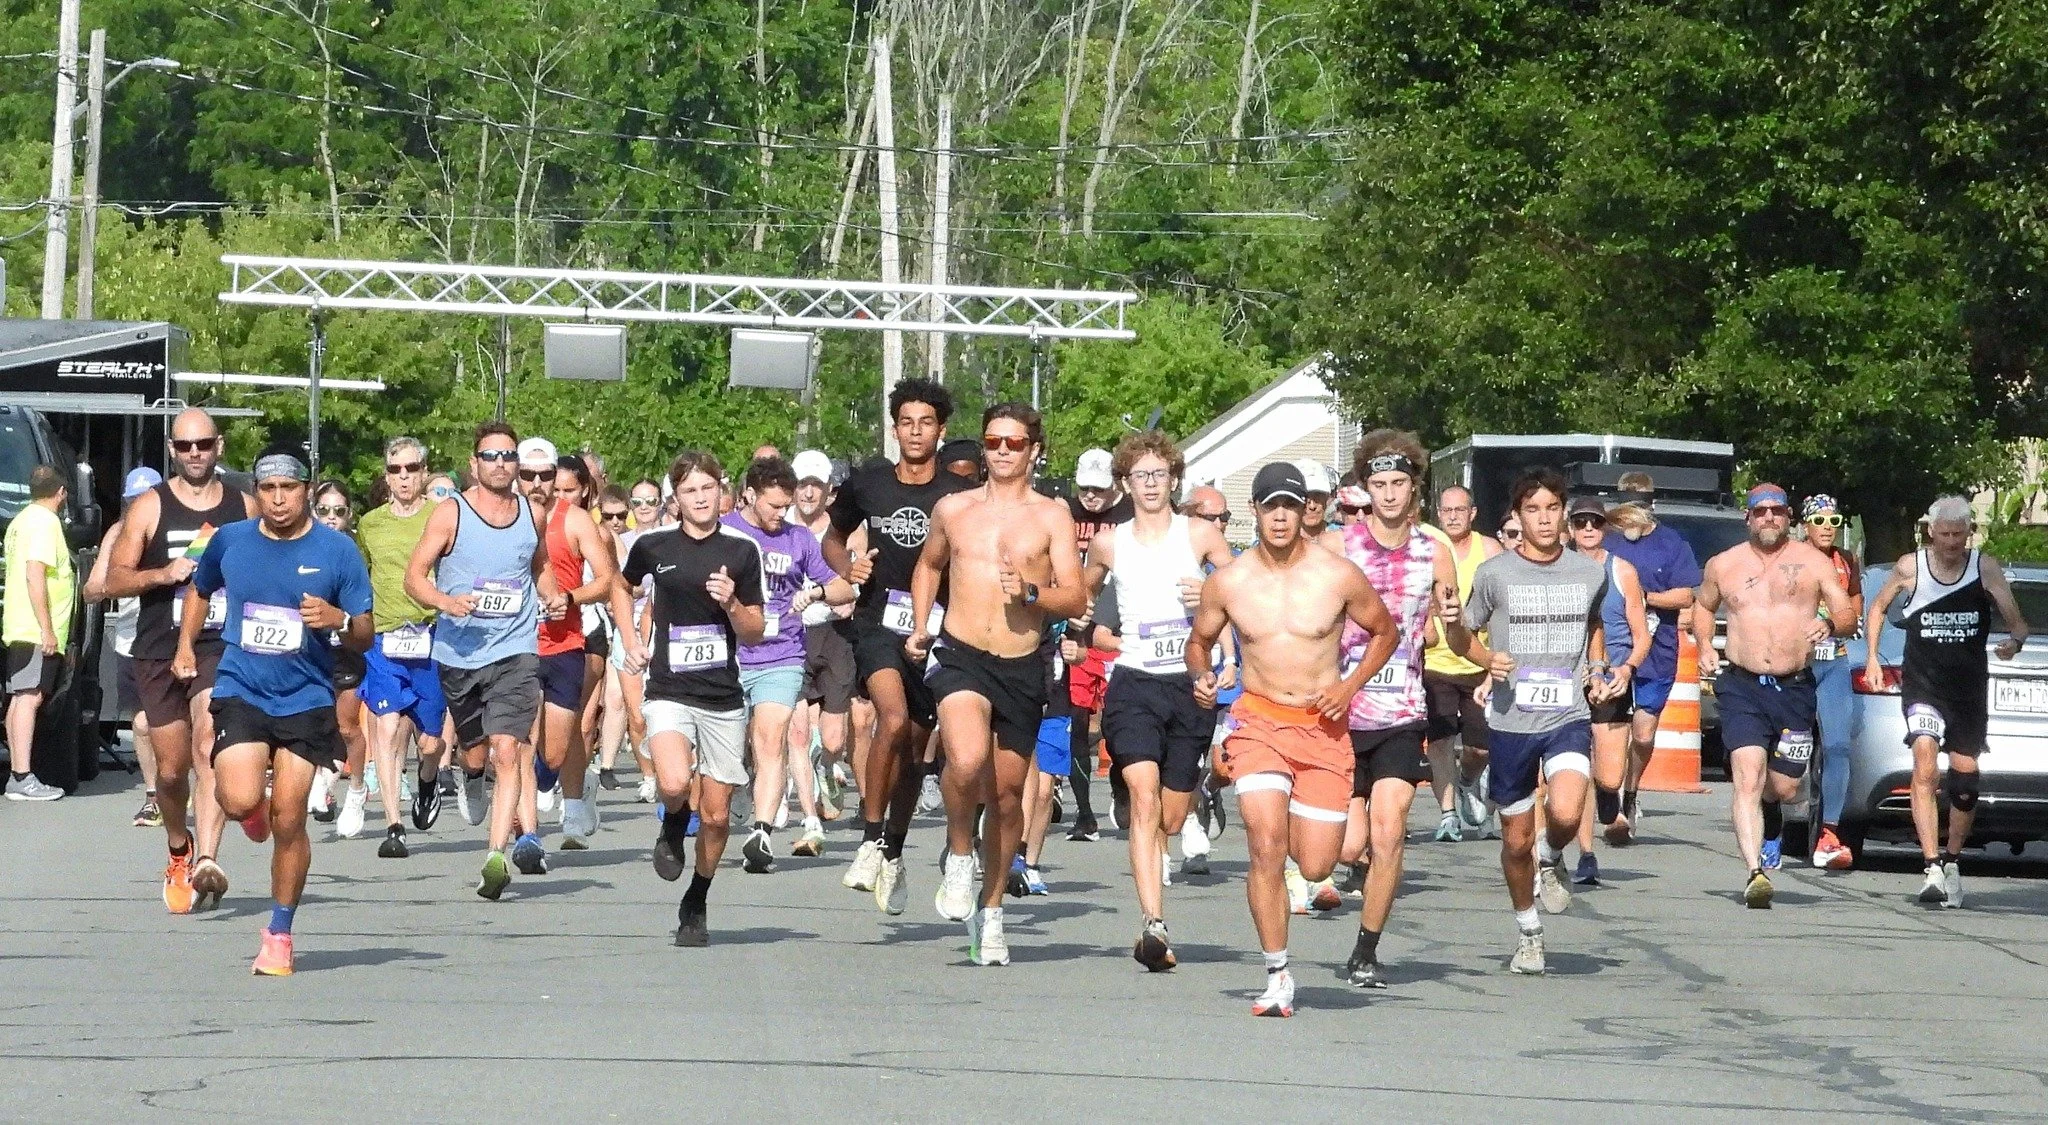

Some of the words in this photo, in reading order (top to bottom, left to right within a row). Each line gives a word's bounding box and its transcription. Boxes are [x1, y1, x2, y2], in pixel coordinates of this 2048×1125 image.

[57, 361, 153, 374] STEALTH
[870, 516, 931, 530] BARKE
[483, 595, 512, 611] 697
[1509, 615, 1547, 624] BARKER
[1549, 614, 1587, 624] RAIDERS
[1920, 611, 1979, 626] CHECKERS
[253, 625, 288, 647] 822
[683, 644, 715, 662] 783
[1154, 638, 1185, 657] 847
[1530, 687, 1559, 704] 791
[1919, 717, 1940, 732] 880
[1789, 745, 1811, 759] 853
